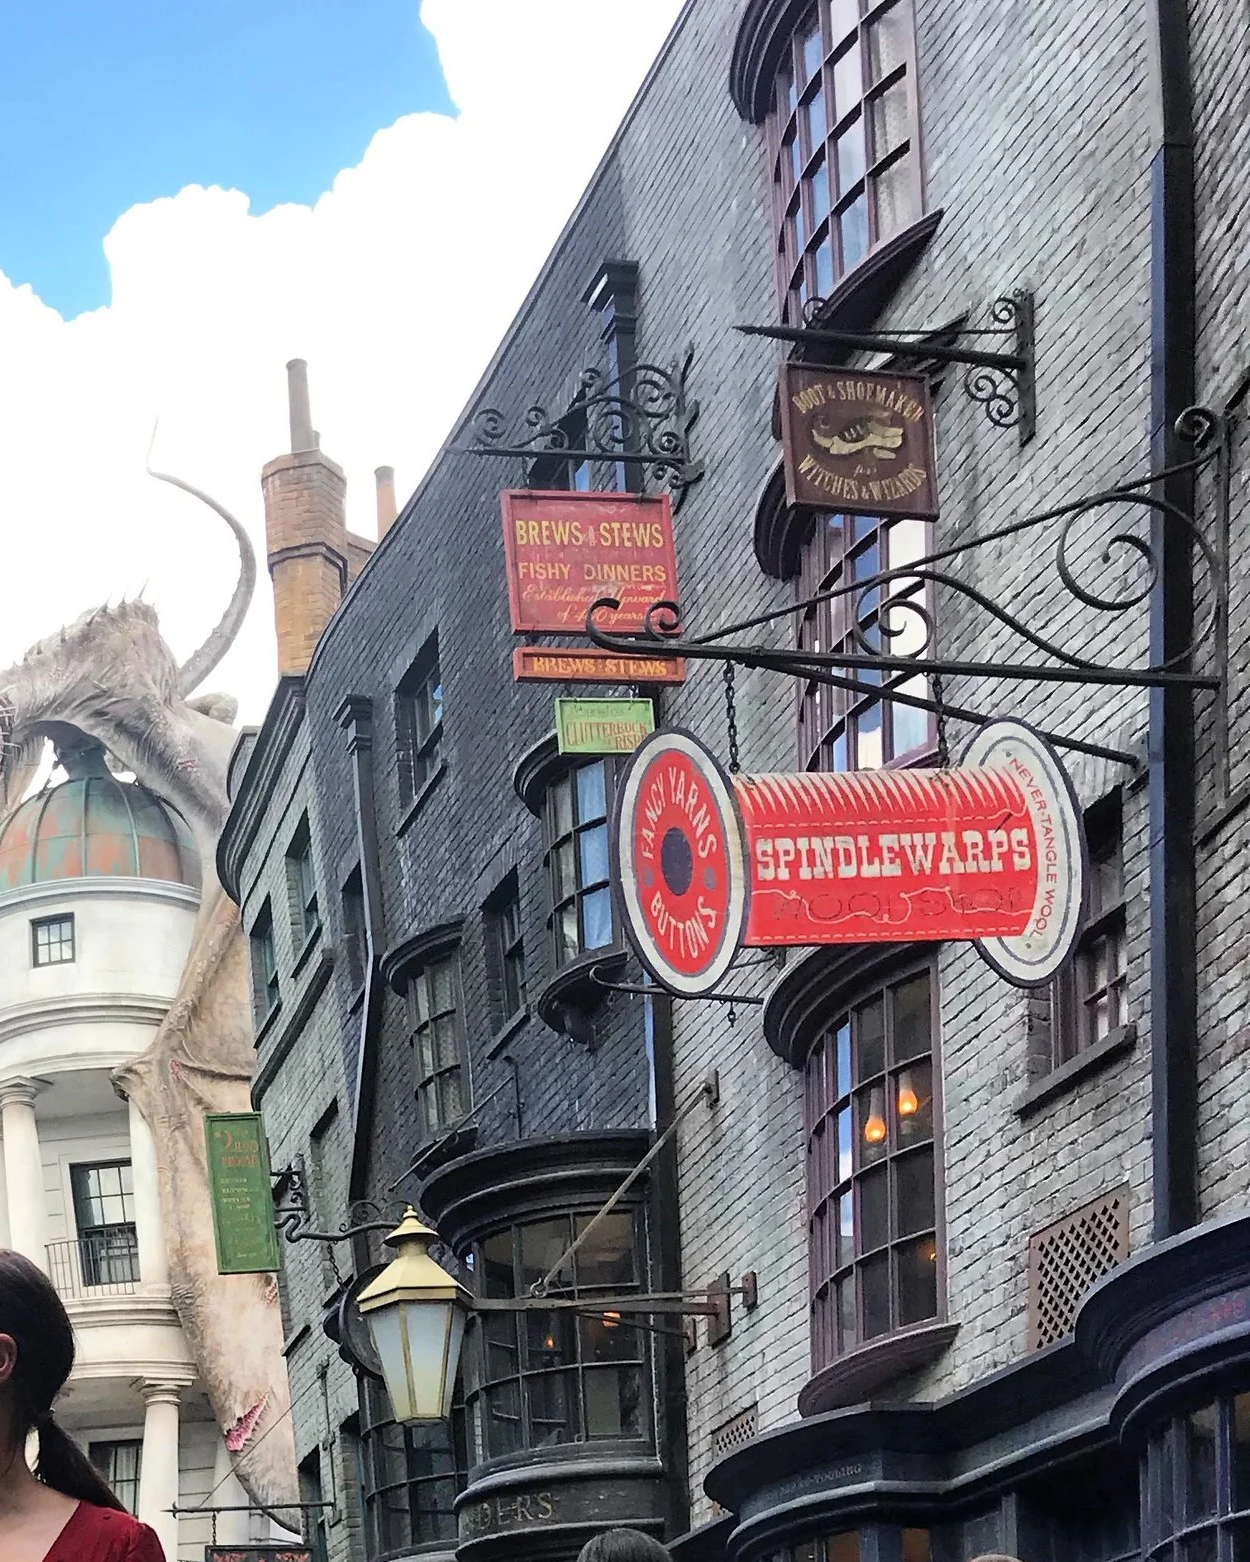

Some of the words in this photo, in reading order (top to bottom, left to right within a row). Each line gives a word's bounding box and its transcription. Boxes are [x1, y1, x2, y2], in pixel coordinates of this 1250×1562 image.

[792, 384, 826, 414] BOOT
[836, 380, 926, 423] SHOEMAKER
[798, 453, 860, 500] WITCHES
[869, 464, 927, 501] WIZARDS
[515, 519, 583, 546] BREWS
[599, 521, 664, 548] STEWS
[518, 562, 571, 580] FISHY
[584, 563, 667, 583] DINNERS
[532, 657, 596, 674] BREWS
[604, 658, 668, 676] STEWS
[642, 771, 666, 860] FANCY
[668, 766, 718, 859] YARNS
[1008, 758, 1058, 885] NEVER-TANGLE
[755, 826, 1032, 881] SPINDLEWARPS
[650, 890, 717, 960] BUTTONS
[1030, 887, 1058, 938] WOOL
